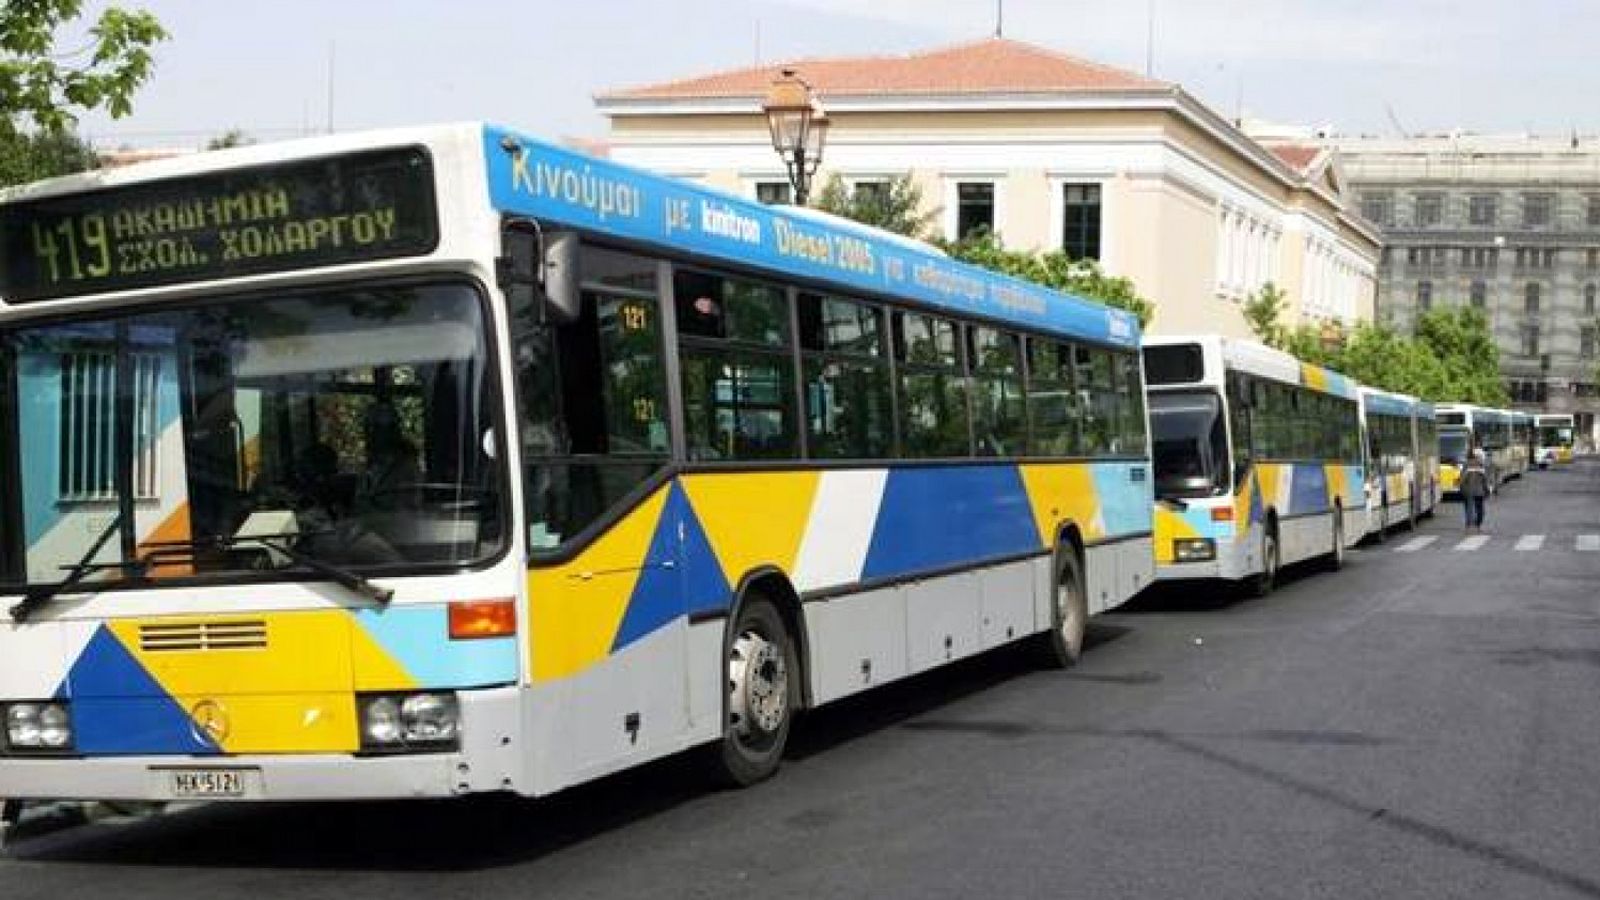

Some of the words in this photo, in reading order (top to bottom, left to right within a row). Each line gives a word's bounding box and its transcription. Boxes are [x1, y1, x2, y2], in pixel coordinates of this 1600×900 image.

[511, 148, 641, 220] Κινούμαι
[664, 197, 691, 237] με
[32, 214, 110, 281] 419
[219, 206, 396, 260] ΧΟΛΑΡΓΟΥ
[623, 304, 646, 329] 121
